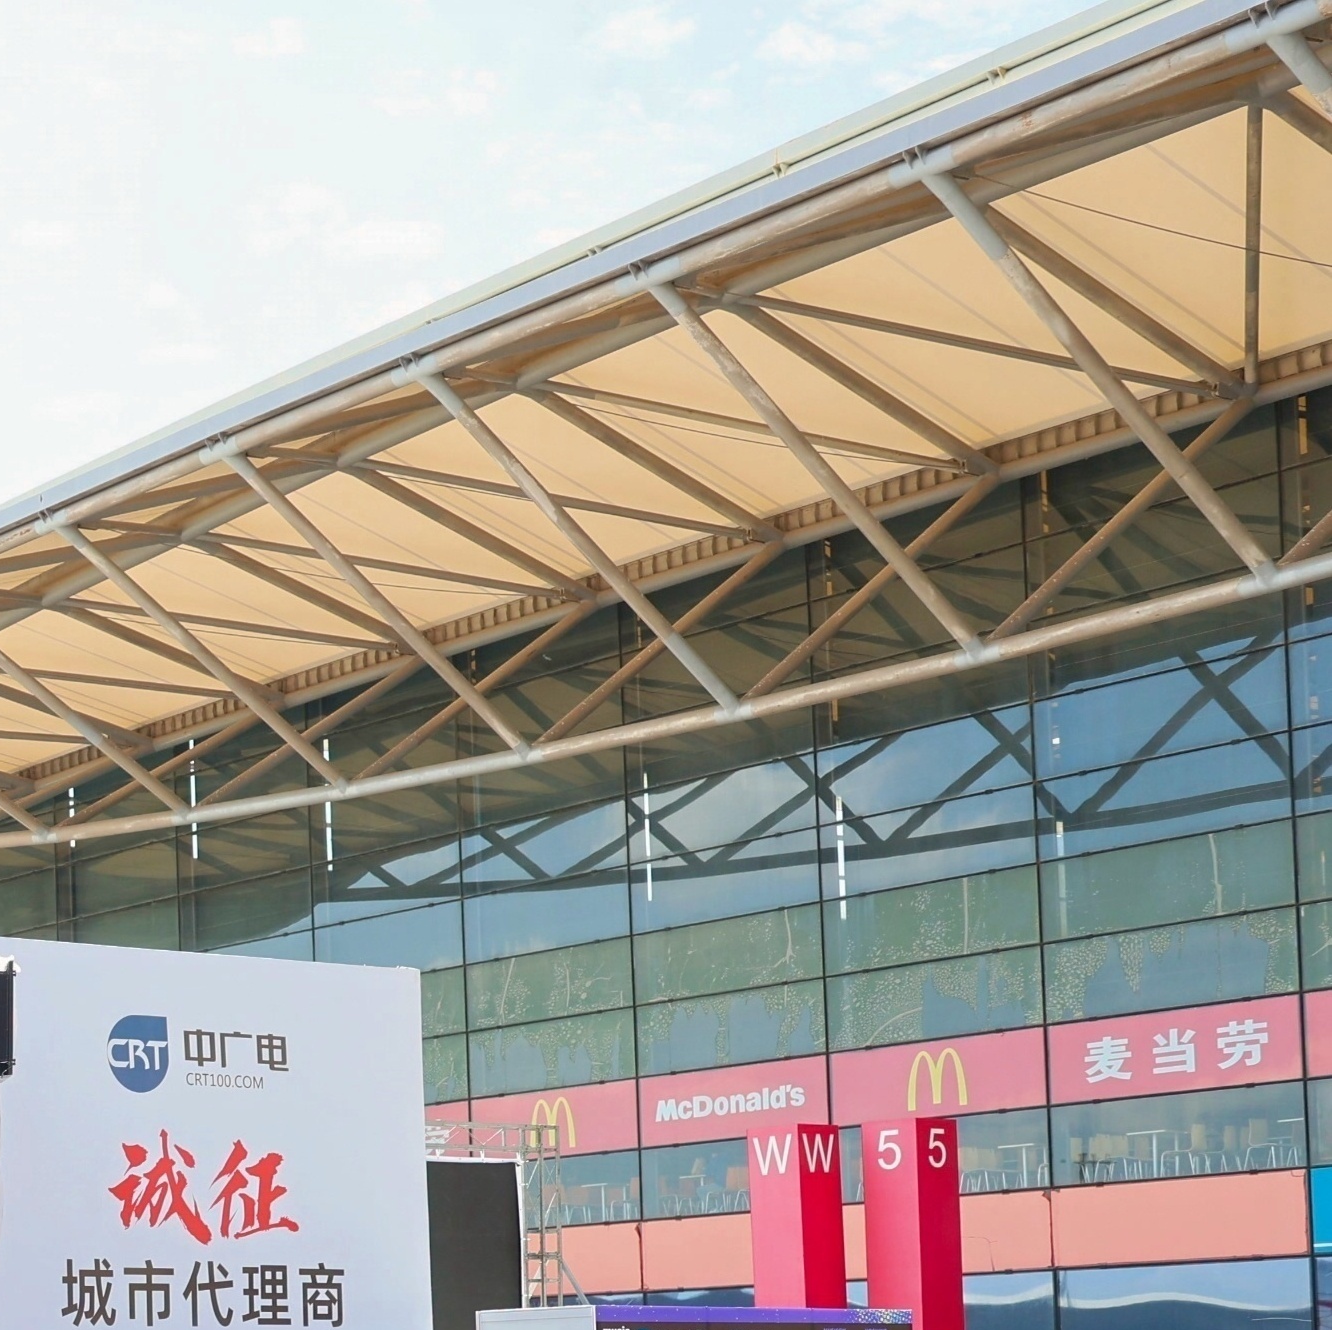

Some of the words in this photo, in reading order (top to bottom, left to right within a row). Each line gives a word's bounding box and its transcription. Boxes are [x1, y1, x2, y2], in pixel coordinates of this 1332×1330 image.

[108, 1037, 168, 1070] CRT
[184, 1029, 289, 1073] 中广电
[1084, 1018, 1270, 1084] 麦当劳
[186, 1073, 264, 1090] CRT100.COM
[656, 1083, 805, 1123] McDonald's
[108, 1128, 300, 1246] 诚征
[61, 1257, 345, 1328] 城市代理商
